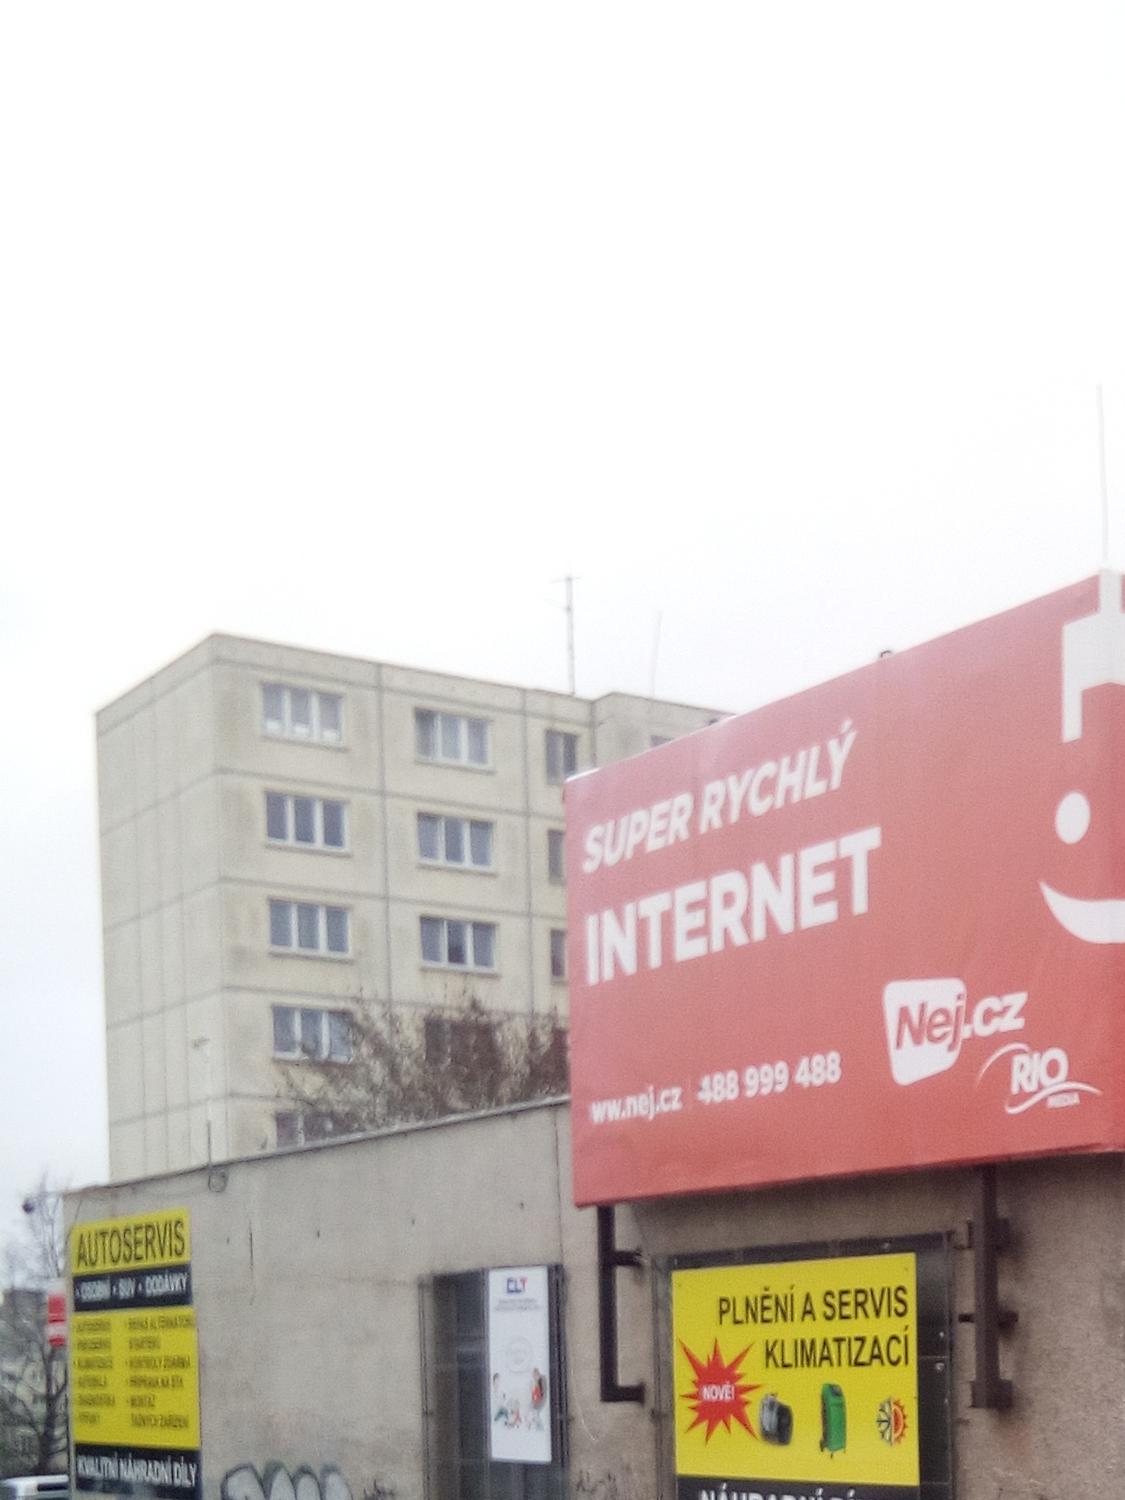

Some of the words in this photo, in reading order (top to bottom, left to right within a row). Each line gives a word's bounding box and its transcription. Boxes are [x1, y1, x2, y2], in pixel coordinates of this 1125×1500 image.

[583, 792, 692, 874] SUPER
[700, 717, 857, 835] RYCHLÝ
[586, 826, 881, 986] INTERNET
[895, 991, 1029, 1053] Nej.cz
[697, 1069, 739, 1104] 488
[745, 1060, 789, 1098] 999
[795, 1050, 842, 1088] 488
[1010, 1047, 1069, 1095] RIO
[77, 1218, 186, 1268] AUTOSERVIS
[719, 1284, 795, 1325] PLNĚNÍ
[801, 1292, 816, 1322] A
[823, 1285, 908, 1321] SERVIS
[765, 1325, 910, 1368] KLIMATIZACÍ
